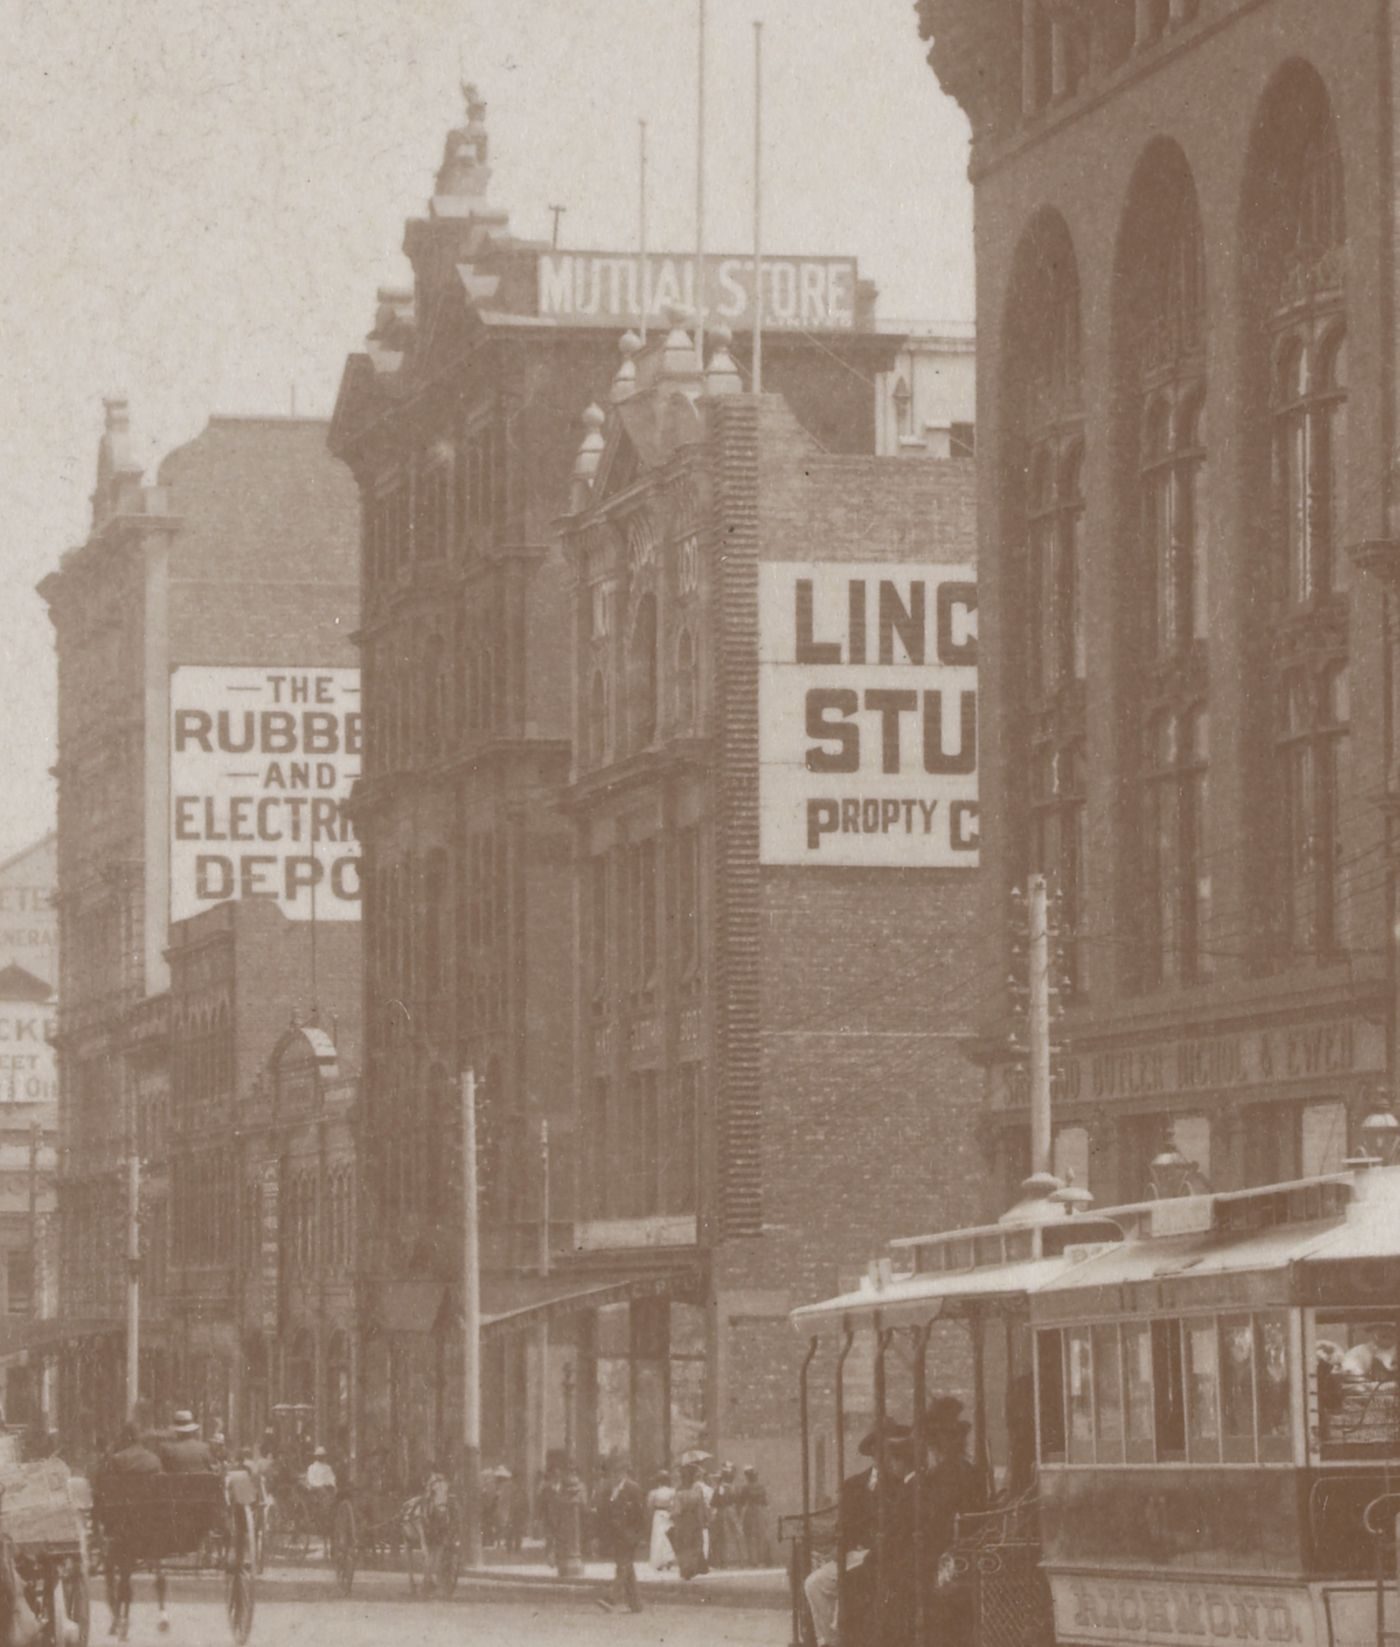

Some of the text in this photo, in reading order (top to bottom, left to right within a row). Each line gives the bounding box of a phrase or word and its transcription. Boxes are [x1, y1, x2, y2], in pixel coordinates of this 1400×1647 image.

[540, 255, 852, 318] MUTUAL STORE
[795, 579, 978, 666] LINC
[266, 675, 336, 704] THE
[805, 688, 976, 775] STU
[264, 762, 337, 789] AND
[806, 798, 979, 851] PROPTY C
[196, 854, 362, 901] DEPO
